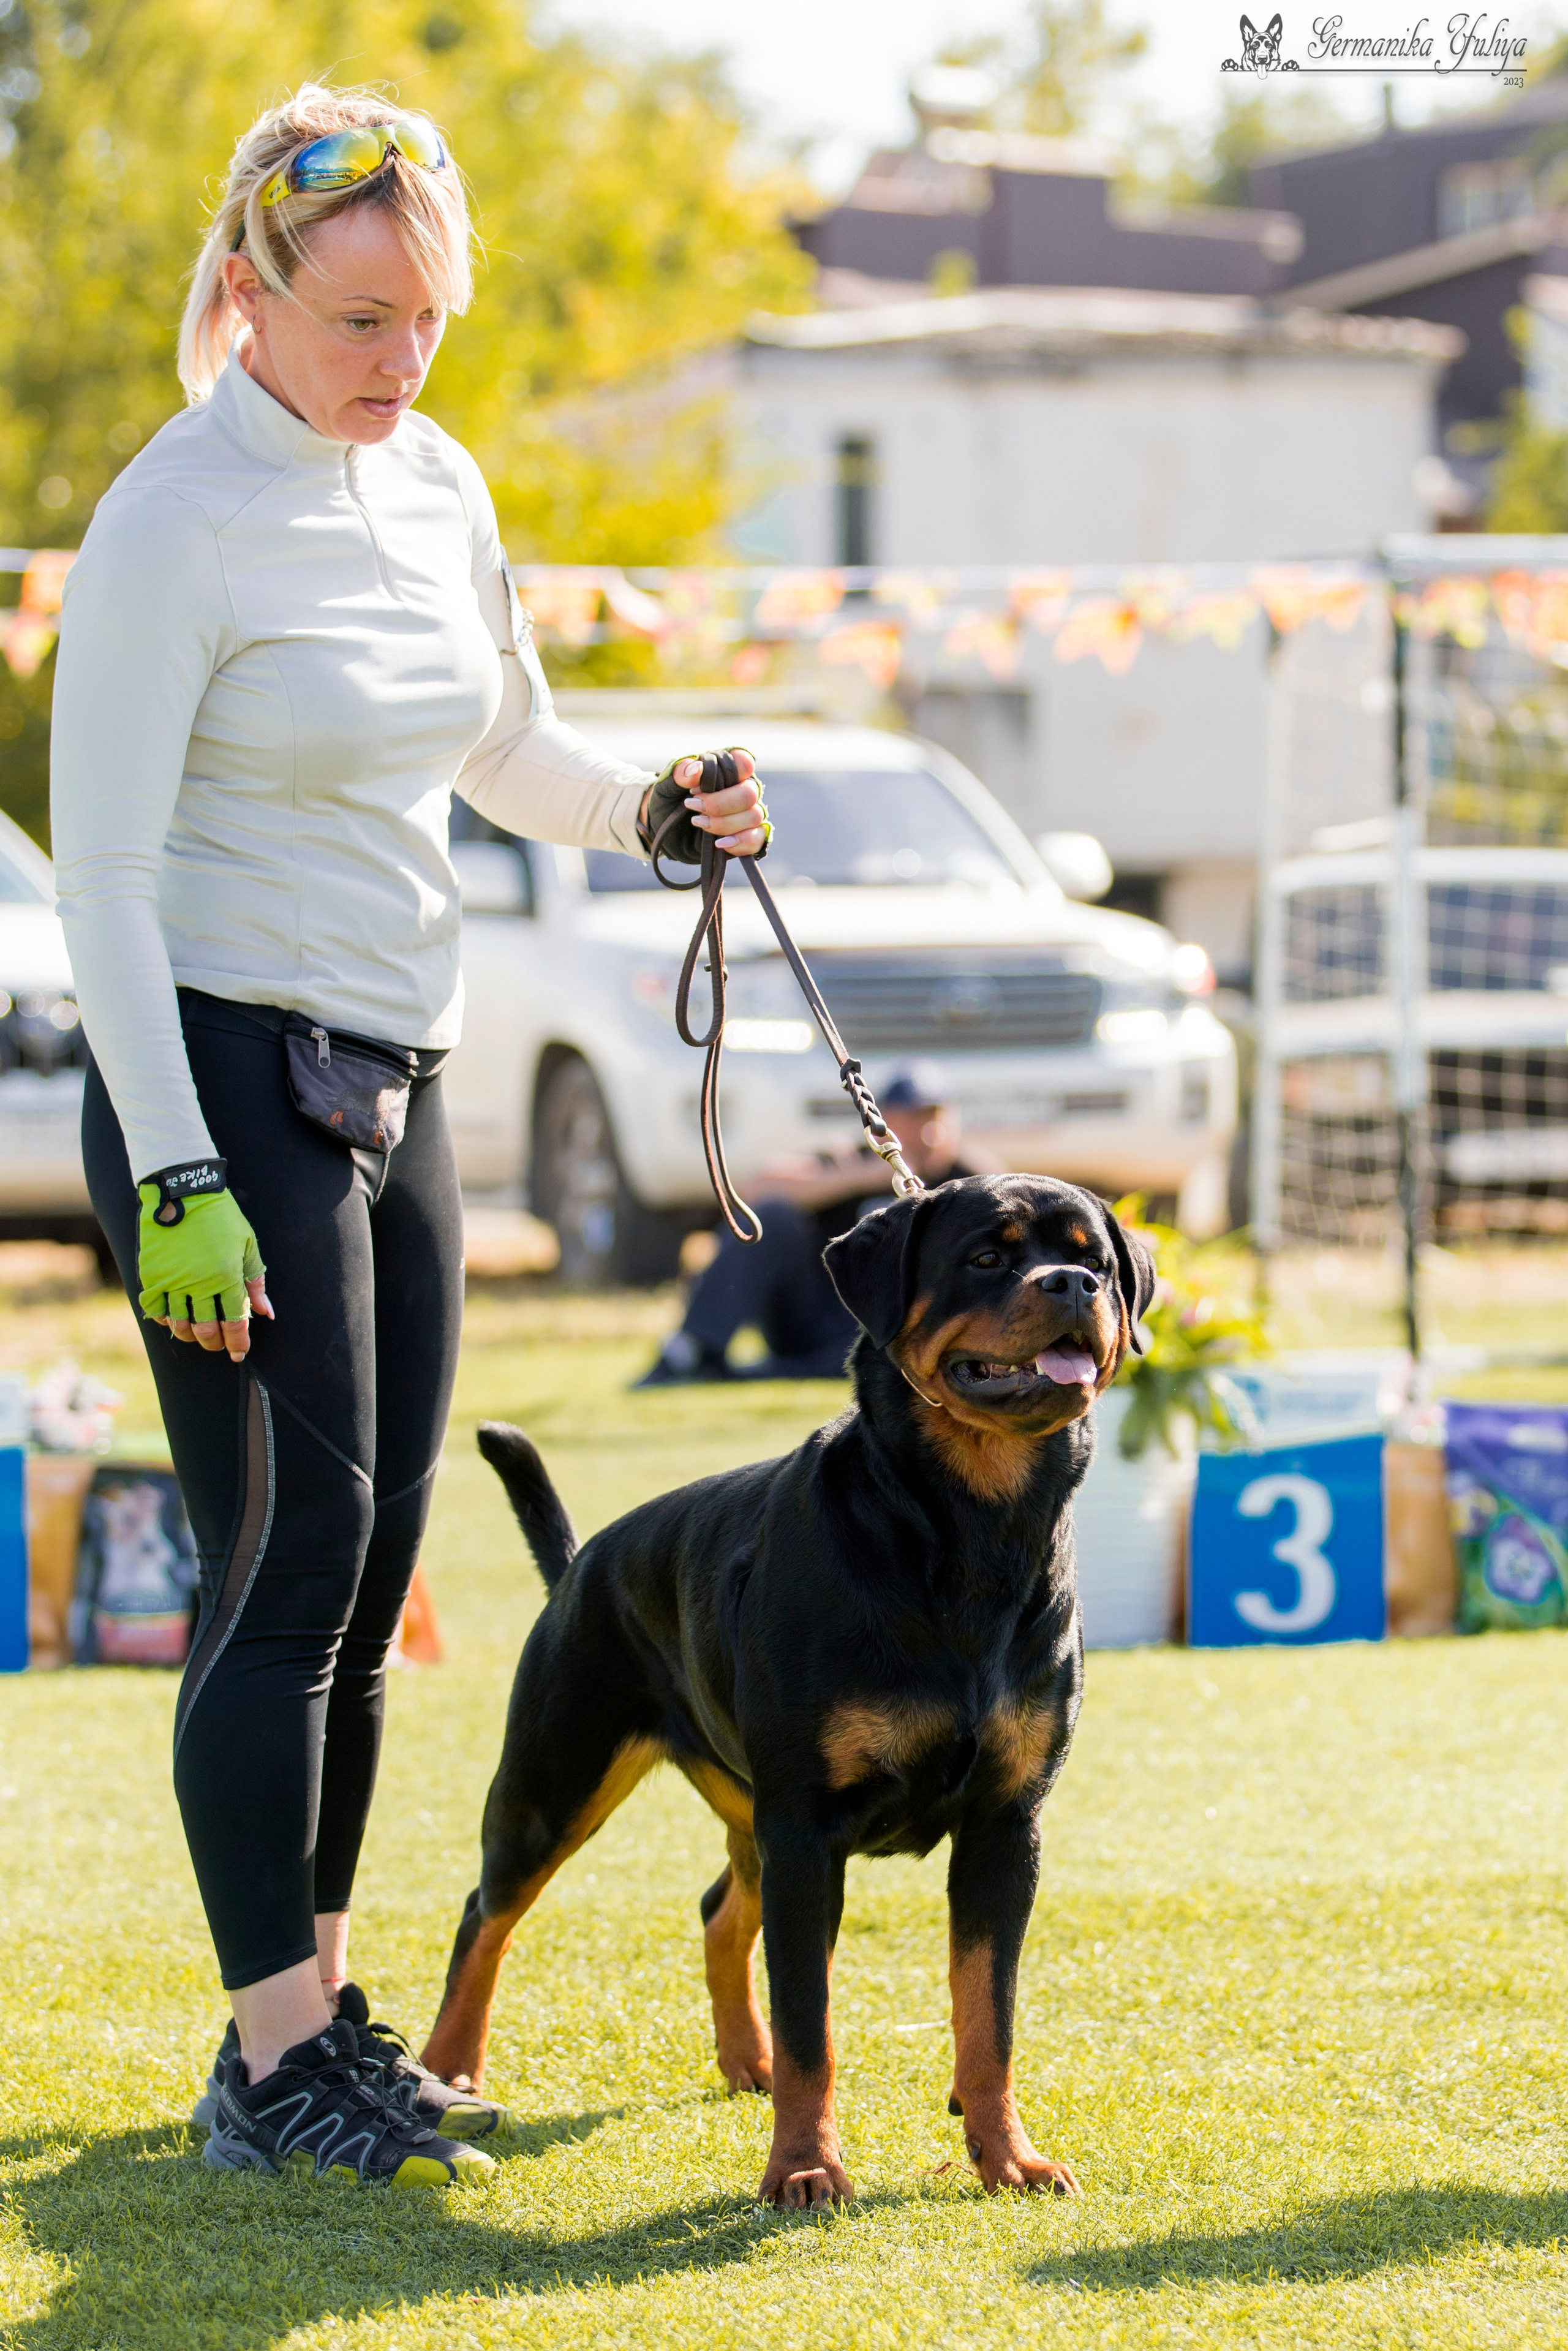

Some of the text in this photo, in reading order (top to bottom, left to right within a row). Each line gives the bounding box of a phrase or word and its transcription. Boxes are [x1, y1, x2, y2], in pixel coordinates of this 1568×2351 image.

[179, 1164, 208, 1182] BIKE
[190, 1171, 219, 1188] GOOD
[1234, 1472, 1336, 1634] 3
